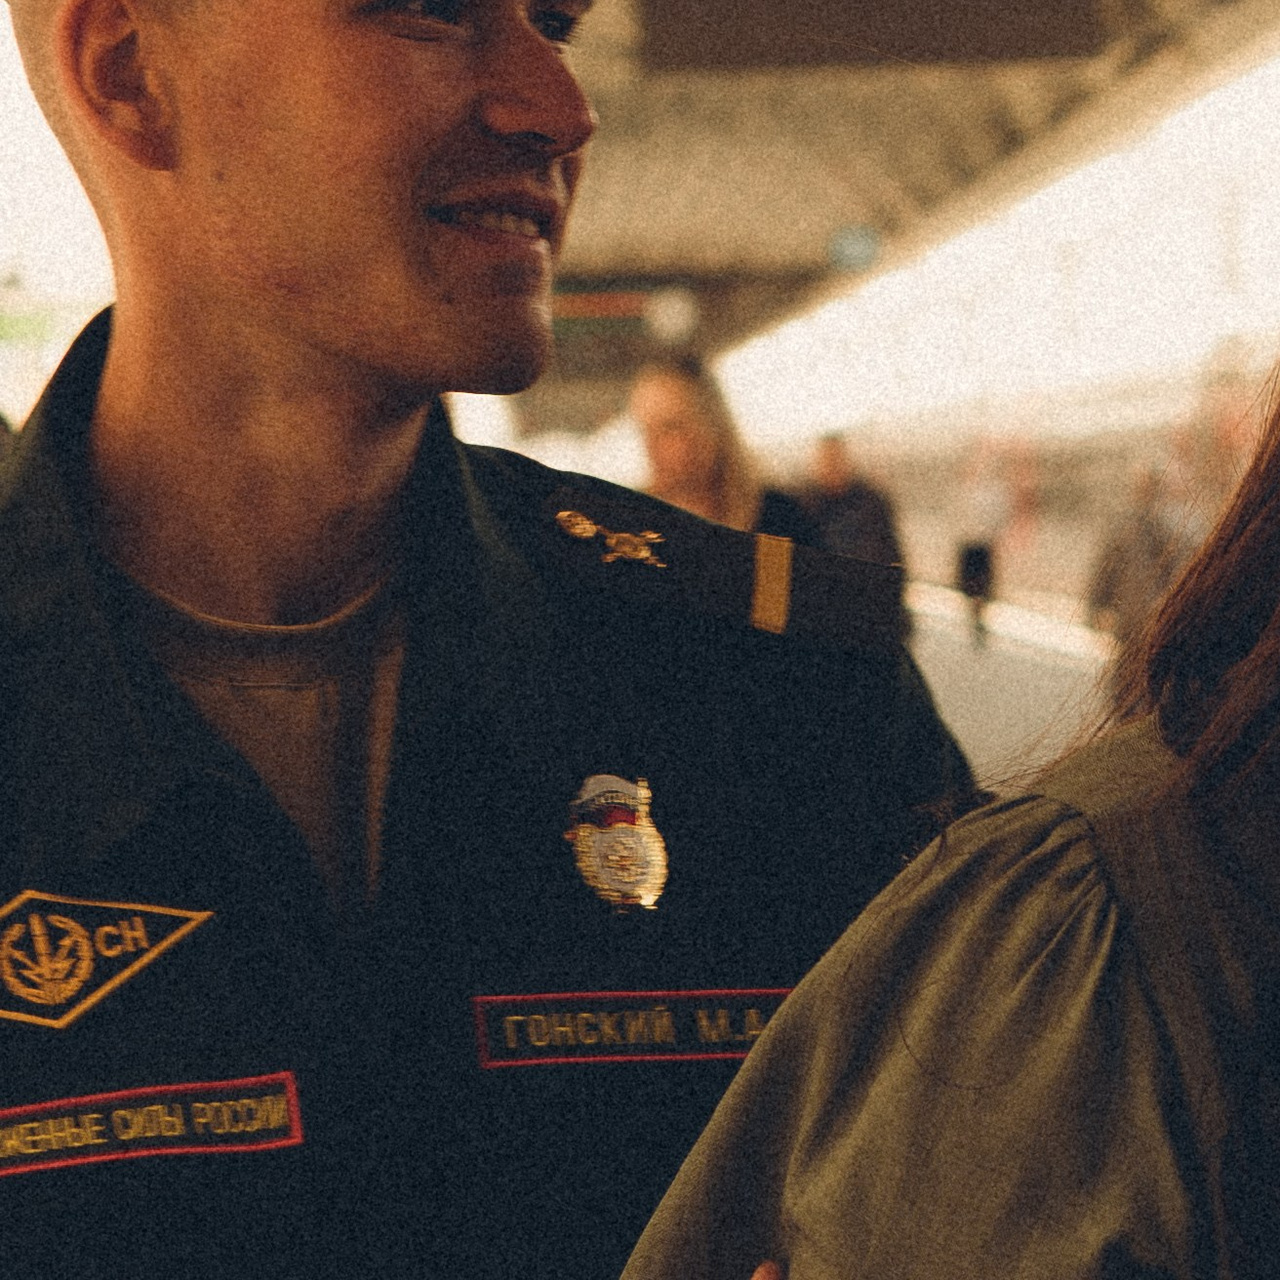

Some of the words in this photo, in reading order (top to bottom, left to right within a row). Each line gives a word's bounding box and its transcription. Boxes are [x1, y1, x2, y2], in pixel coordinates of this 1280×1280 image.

[503, 1005, 676, 1049] ГОНСКИЙ
[112, 1104, 186, 1140] СИЛЫ
[191, 1094, 289, 1135] РОССИИ
